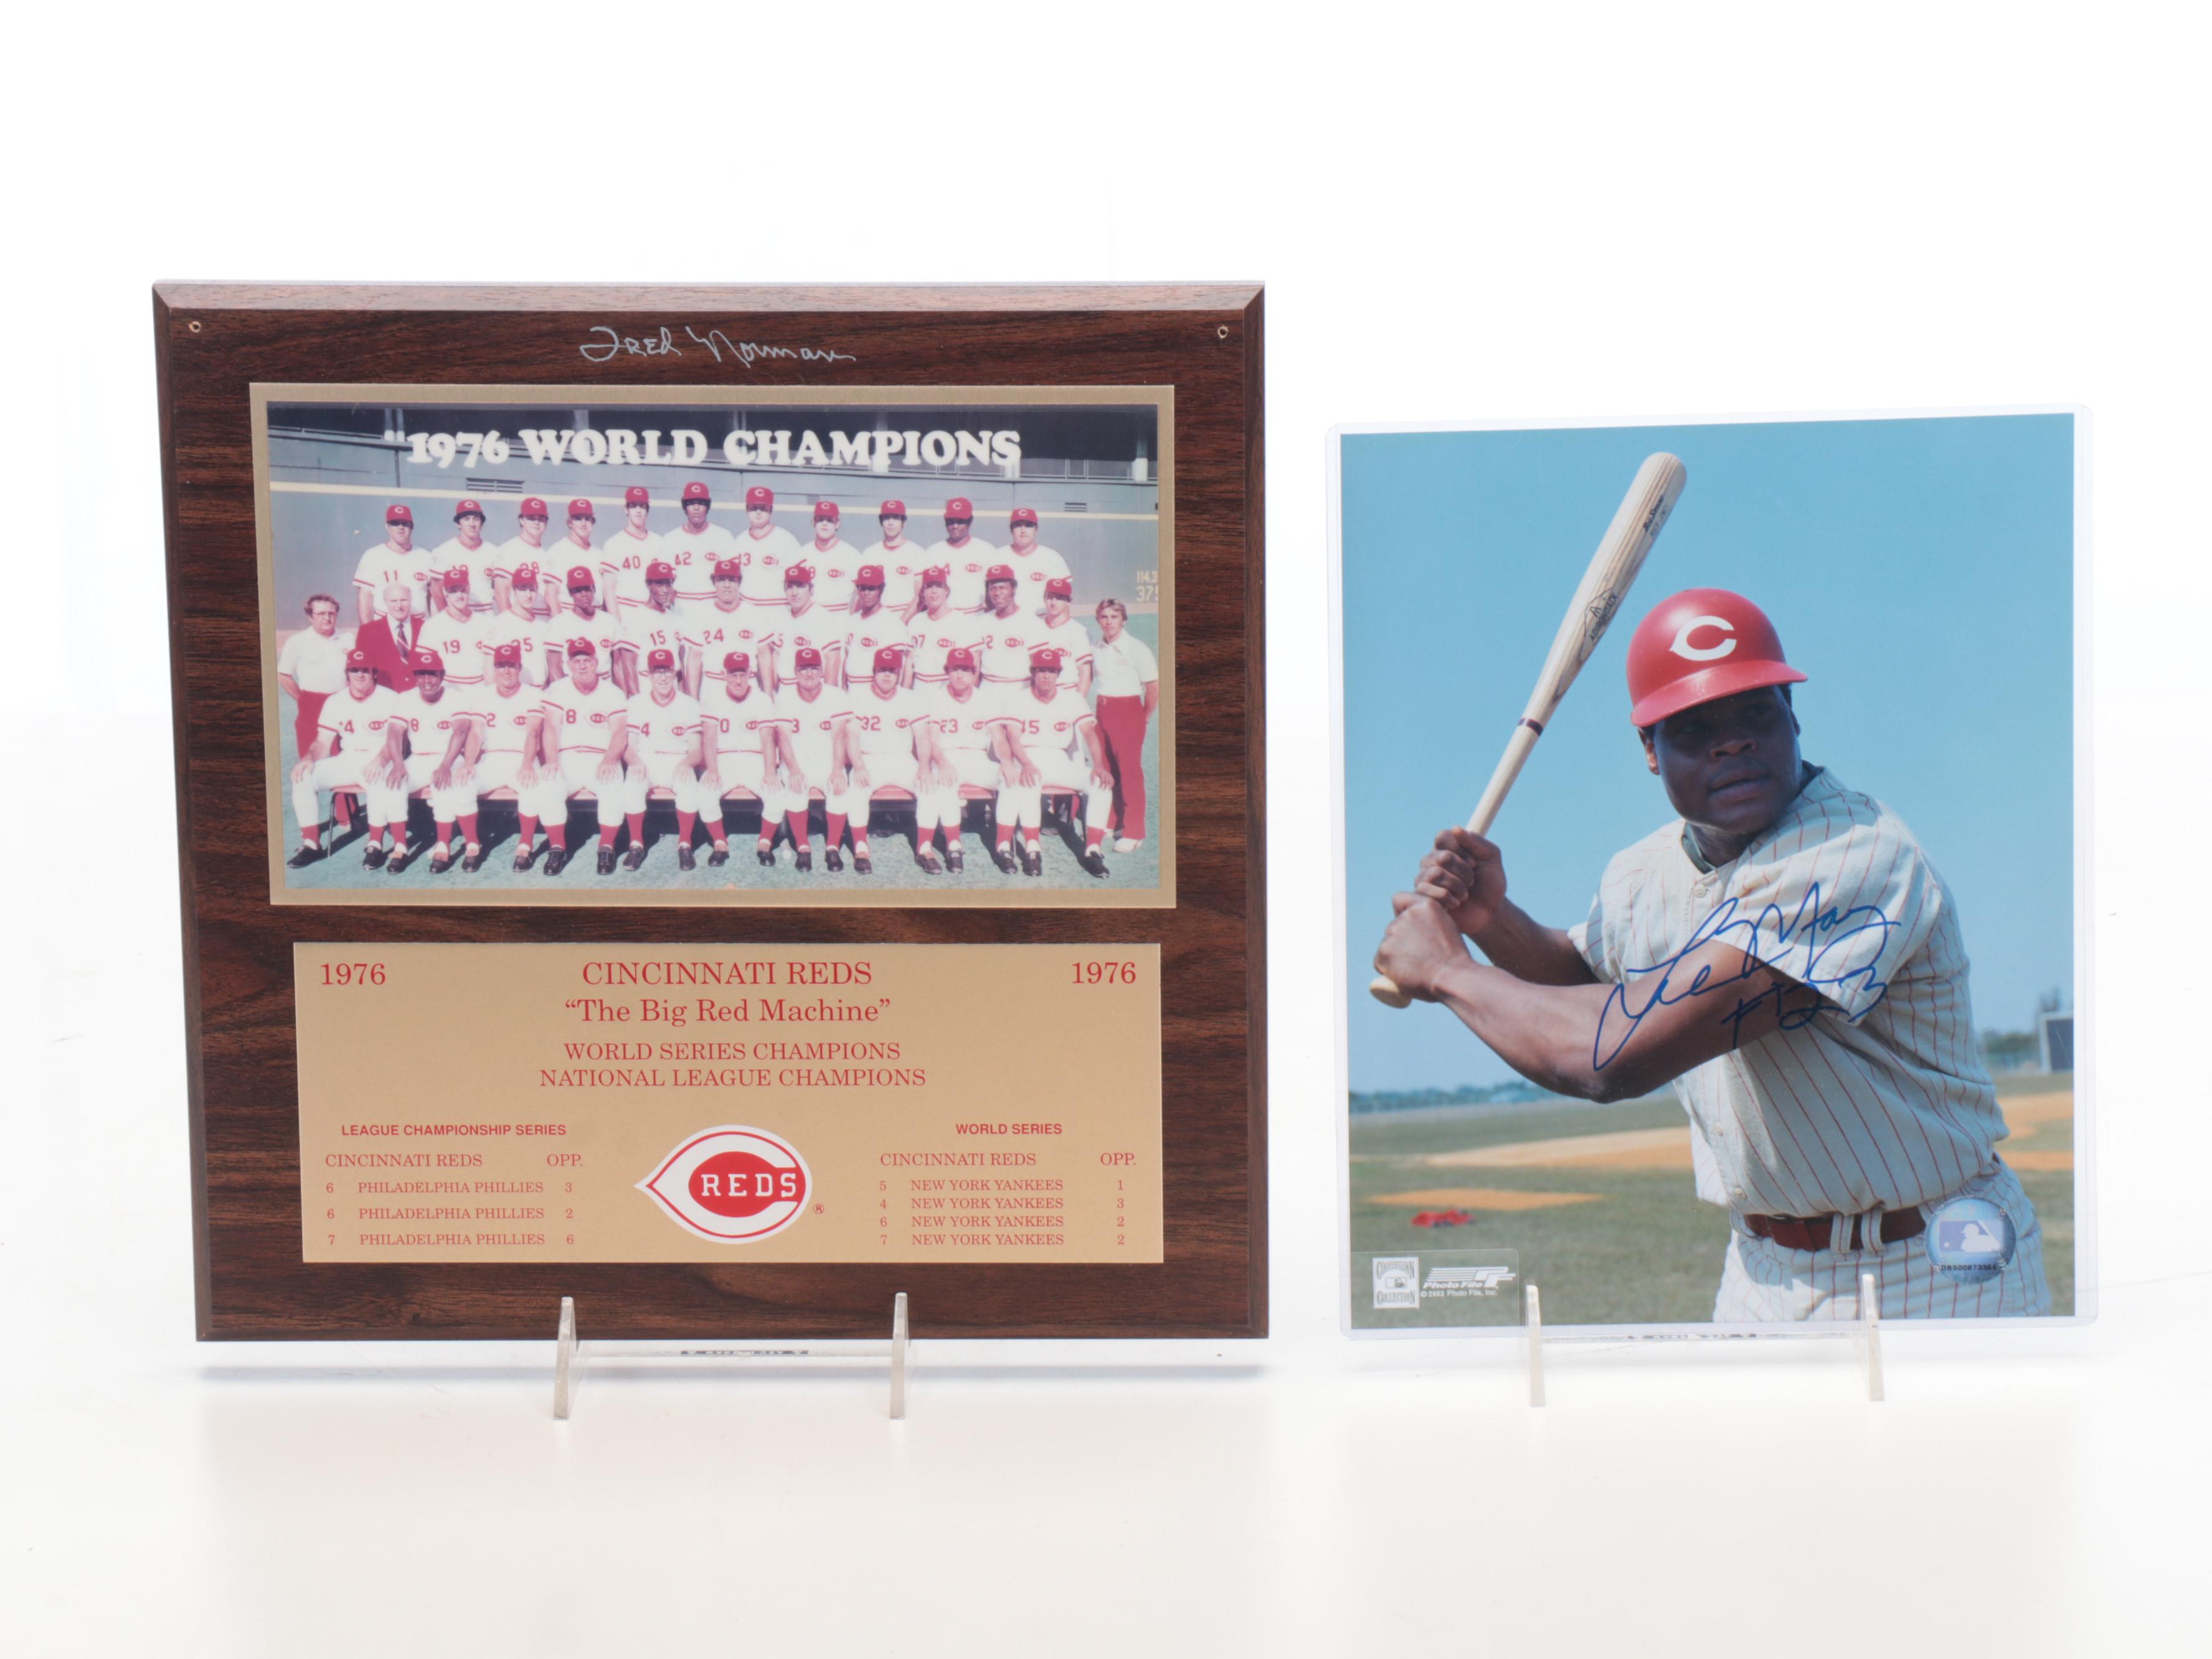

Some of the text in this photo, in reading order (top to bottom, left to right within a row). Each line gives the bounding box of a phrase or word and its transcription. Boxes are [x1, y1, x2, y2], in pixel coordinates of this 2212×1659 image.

[407, 428, 1022, 468] 1976 WORLD CHAMPIONS
[622, 555, 641, 570] 40
[650, 630, 666, 646] 15
[702, 628, 724, 645] 24
[1668, 615, 1737, 662] C
[443, 639, 461, 654] 19
[320, 963, 386, 986] 1976
[582, 961, 872, 985] CINCINNATI REDS
[1072, 961, 1137, 985] 1976
[640, 999, 688, 1028] Big
[696, 998, 750, 1022] Red
[563, 1042, 900, 1061] WORLD SERIES CHAMPIONS
[539, 1068, 926, 1087] NATIONAL LEAGUE CHAMPIONS
[341, 1123, 567, 1137] LEAGUE CHAMPIONSHIP SERIES
[955, 1123, 1063, 1135] WORLD SERIES
[325, 1153, 583, 1167] CINCINNATI REDS OPP.
[880, 1152, 1137, 1166] CINCINNATI REDS OPP.
[326, 1182, 573, 1193] 6 PHILADELPHIA PHILLIES 3
[701, 1172, 796, 1198] REDS
[879, 1179, 1123, 1191] 5 NEW YORK YANKEES 1
[879, 1198, 1125, 1209] 4 NEW YORK YANKEES 3
[327, 1208, 574, 1219] 6 PHILADELPHIA PHILLIES 2
[879, 1216, 1125, 1227] 6 NEW YORK YANKEES 2
[328, 1234, 574, 1245] 7 PHILADELPHIA PHILLIES 6
[879, 1234, 1125, 1245] 7 NEW YORK YANKEES 2
[1422, 1281, 1460, 1289] Photo
[1447, 1288, 1468, 1297] Photo
[1468, 1288, 1483, 1297] File,
[1485, 1288, 1498, 1296] Inc.
